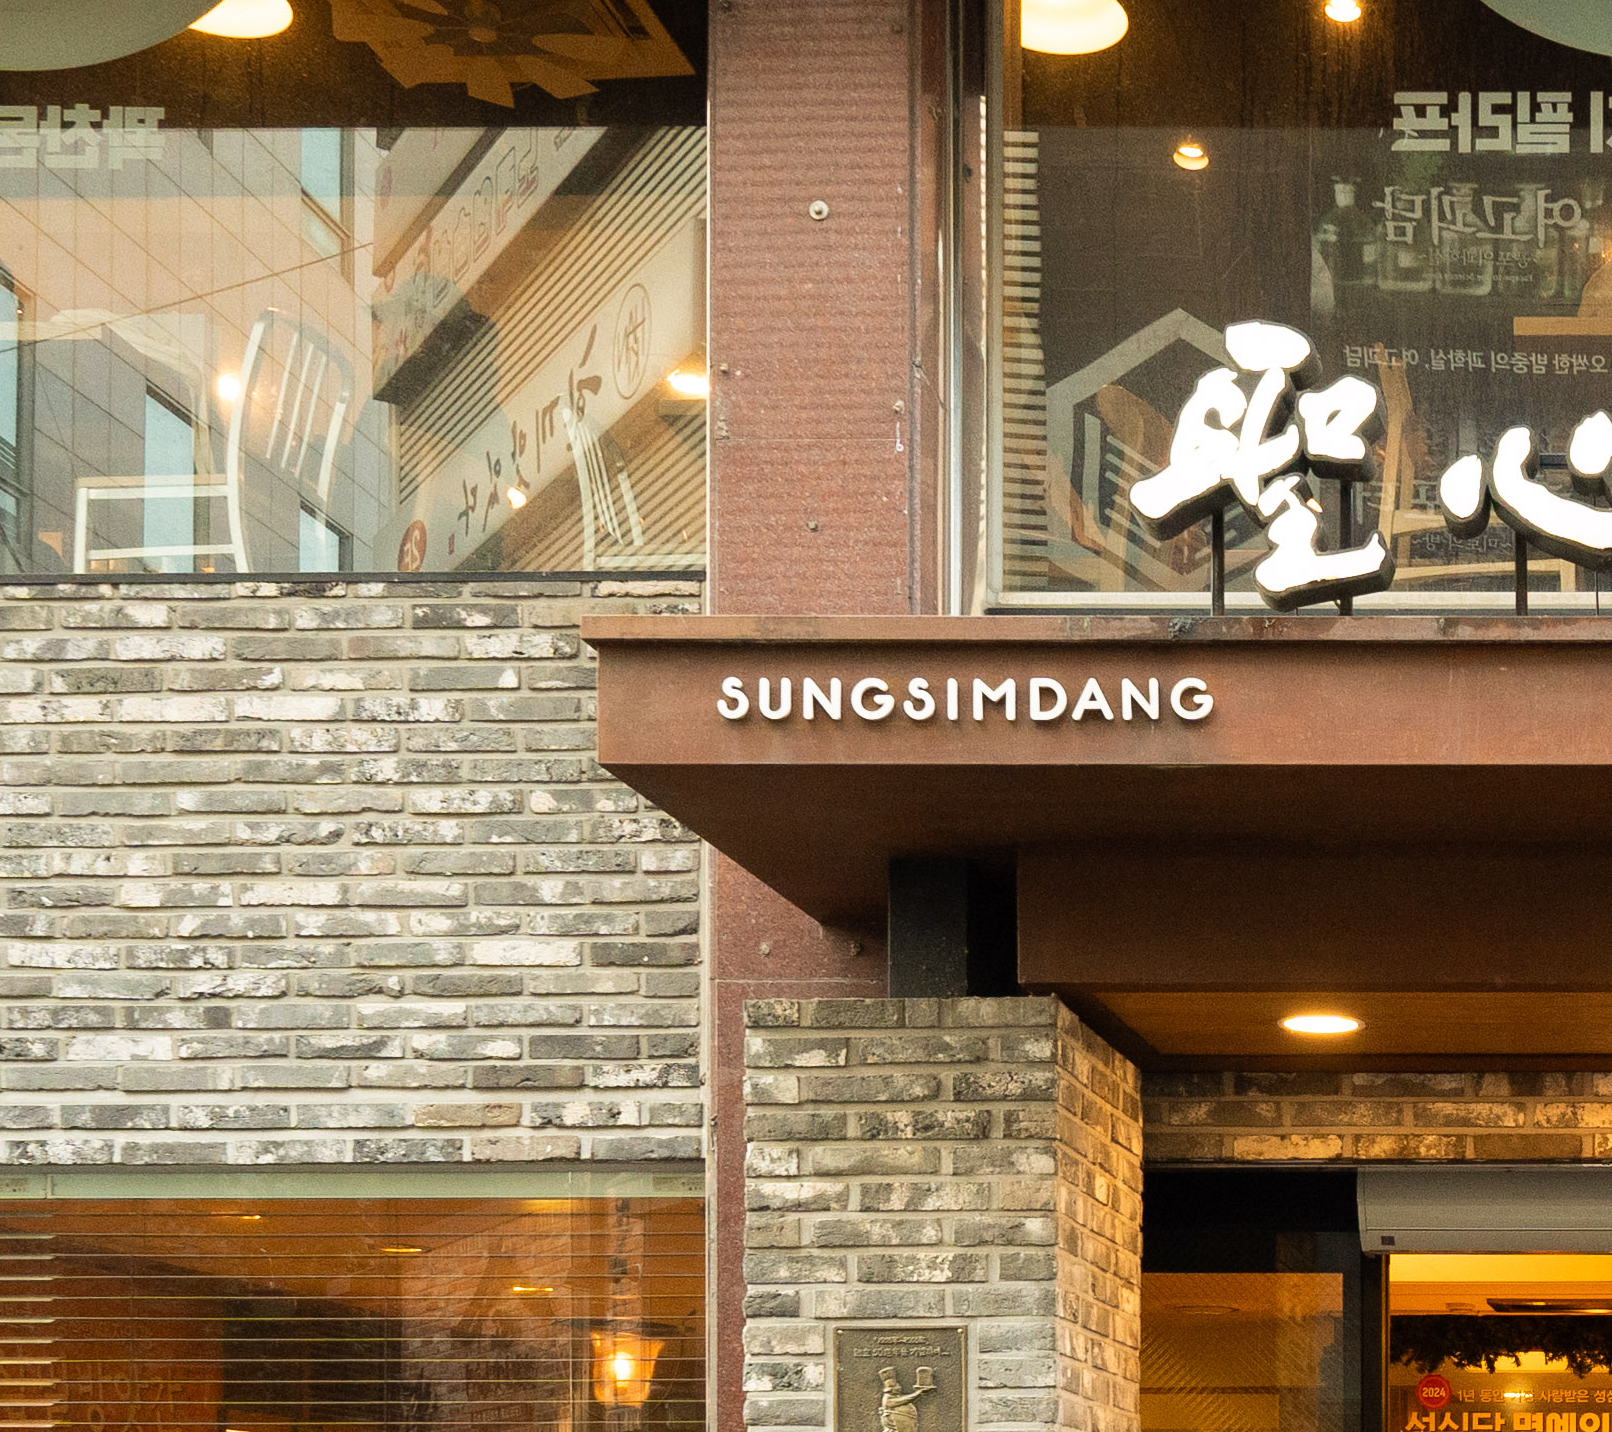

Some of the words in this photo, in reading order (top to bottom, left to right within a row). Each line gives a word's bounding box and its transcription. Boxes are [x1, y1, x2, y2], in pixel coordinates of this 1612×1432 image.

[715, 674, 1215, 725] SUNGSIMDANG
[1422, 1387, 1446, 1398] 2024
[1539, 1389, 1589, 1403] 사랑받은
